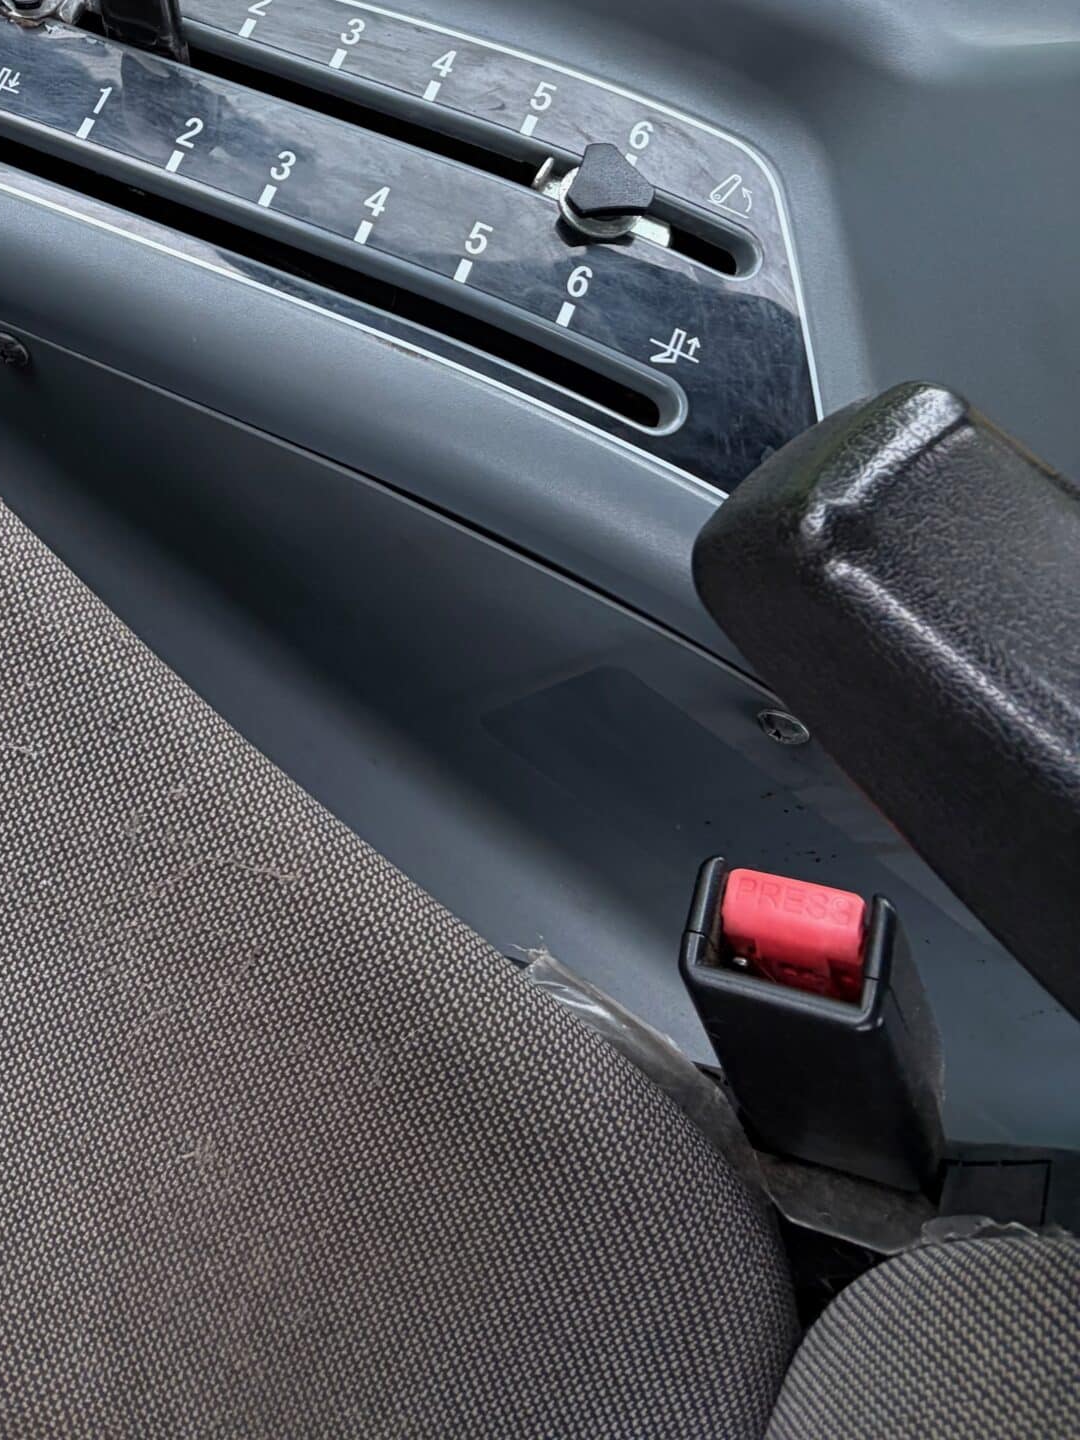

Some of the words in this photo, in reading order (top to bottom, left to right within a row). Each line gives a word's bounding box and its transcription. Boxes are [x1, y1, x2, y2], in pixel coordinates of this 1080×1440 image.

[340, 19, 366, 46] 3
[431, 50, 457, 78] 4
[530, 81, 558, 112] 5
[628, 121, 654, 150] 6
[93, 86, 113, 114] 1
[175, 117, 204, 149] 2
[270, 151, 297, 181] 3
[363, 186, 391, 217] 4
[464, 222, 493, 256] 5
[566, 265, 593, 298] 6
[735, 878, 853, 926] PRESS
